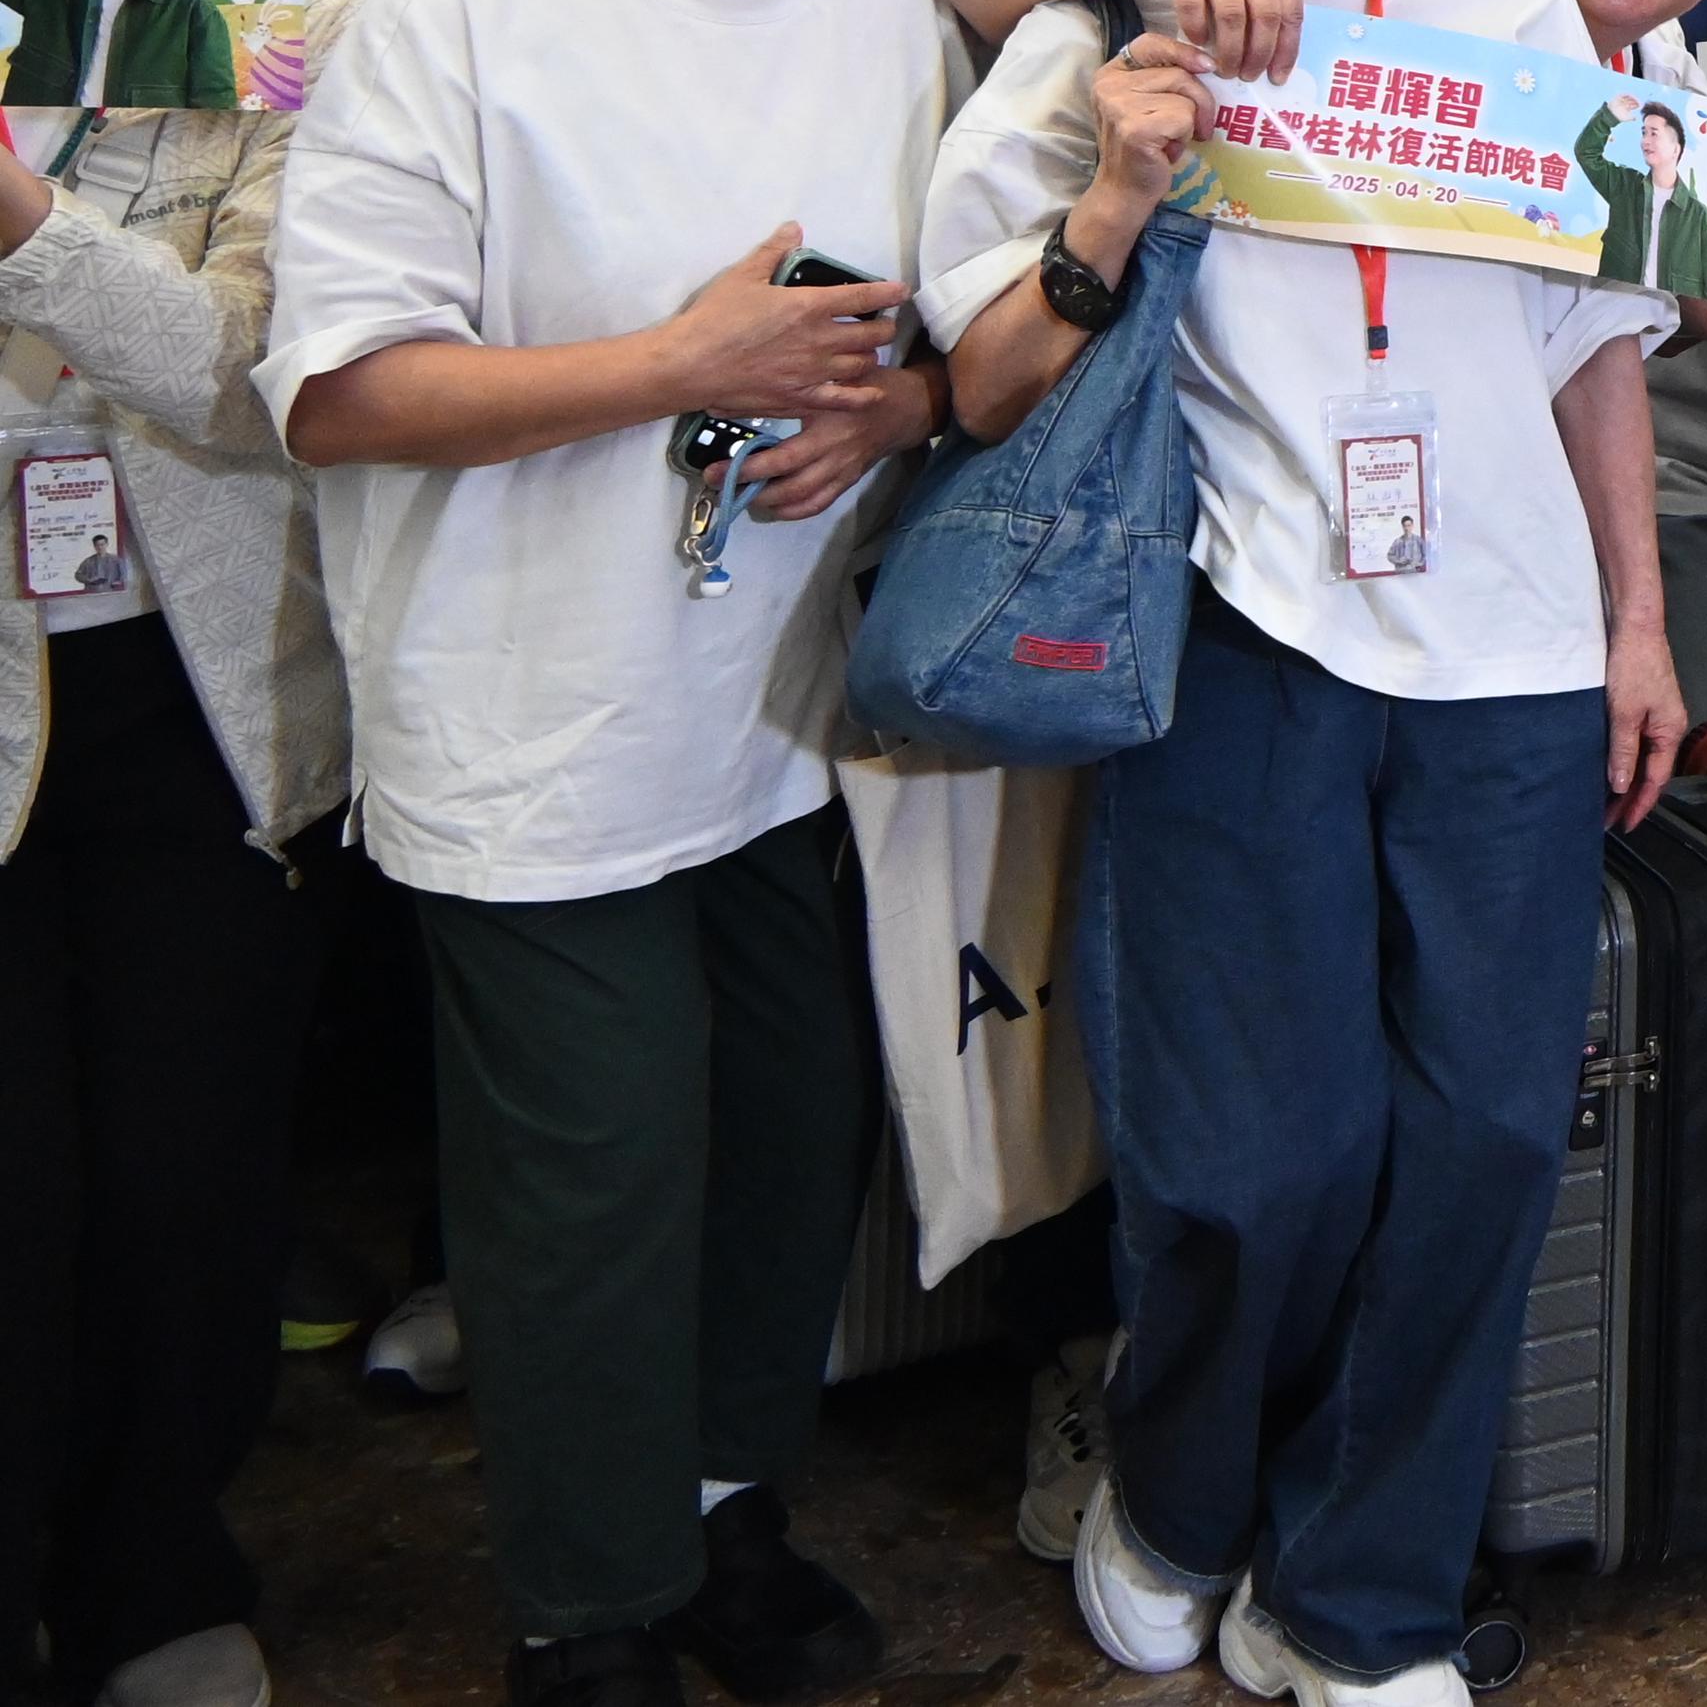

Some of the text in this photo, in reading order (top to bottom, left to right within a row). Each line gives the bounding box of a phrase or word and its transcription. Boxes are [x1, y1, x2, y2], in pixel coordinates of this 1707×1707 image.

[1326, 58, 1485, 130] 譚輝智
[1213, 102, 1574, 194] 唱響桂林復活節晚會
